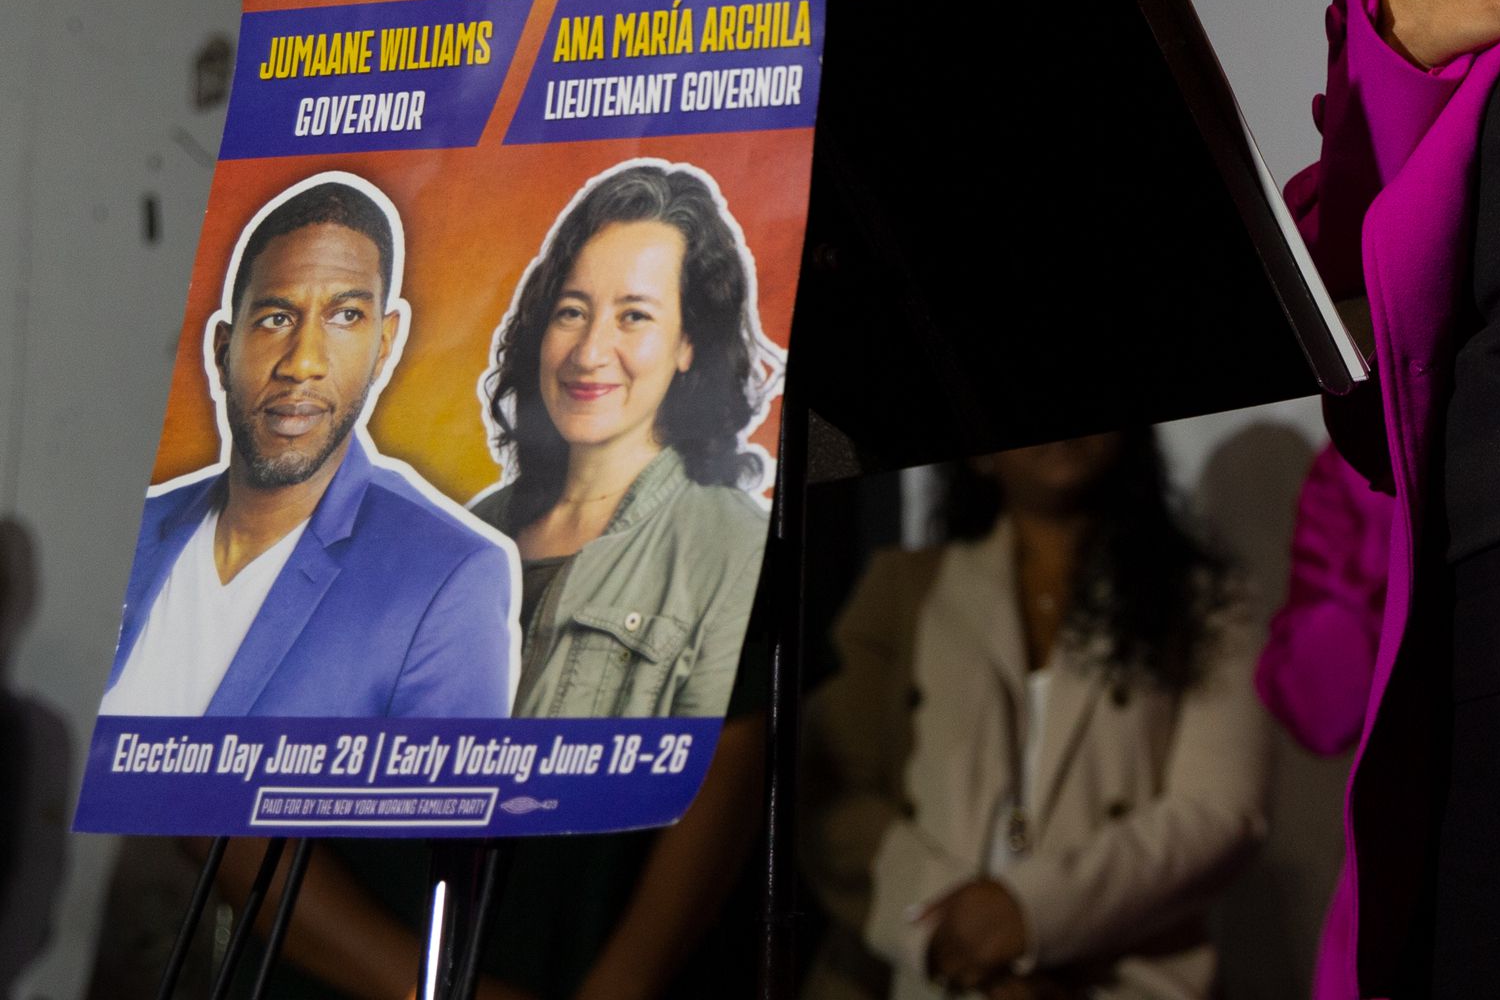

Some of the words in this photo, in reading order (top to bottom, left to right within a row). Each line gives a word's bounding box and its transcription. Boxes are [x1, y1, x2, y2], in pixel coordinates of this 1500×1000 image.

[259, 30, 374, 80] JUMAANE
[380, 20, 493, 71] WILLIAMS
[553, 17, 608, 63] ANA
[612, 0, 694, 58] MARÍA
[701, 1, 812, 53] ARCHILA
[294, 91, 426, 137] GOVERNOR
[544, 73, 678, 120] LIEUTENANT
[680, 65, 803, 112] GOVERNOR
[112, 733, 217, 775] Election
[219, 735, 262, 783] Day
[265, 735, 326, 776] June
[329, 735, 366, 775] 28
[386, 734, 450, 782] Early
[453, 735, 538, 782] Voting
[539, 736, 603, 776] June
[261, 798, 283, 815] PAID
[283, 798, 302, 815] FOR
[302, 798, 316, 815] BY
[316, 798, 334, 815] THE
[333, 798, 354, 815] NEW
[354, 798, 378, 815] YORK
[378, 798, 418, 815] WORKING
[418, 798, 456, 815] FAMILIES
[457, 798, 487, 815] PARTY
